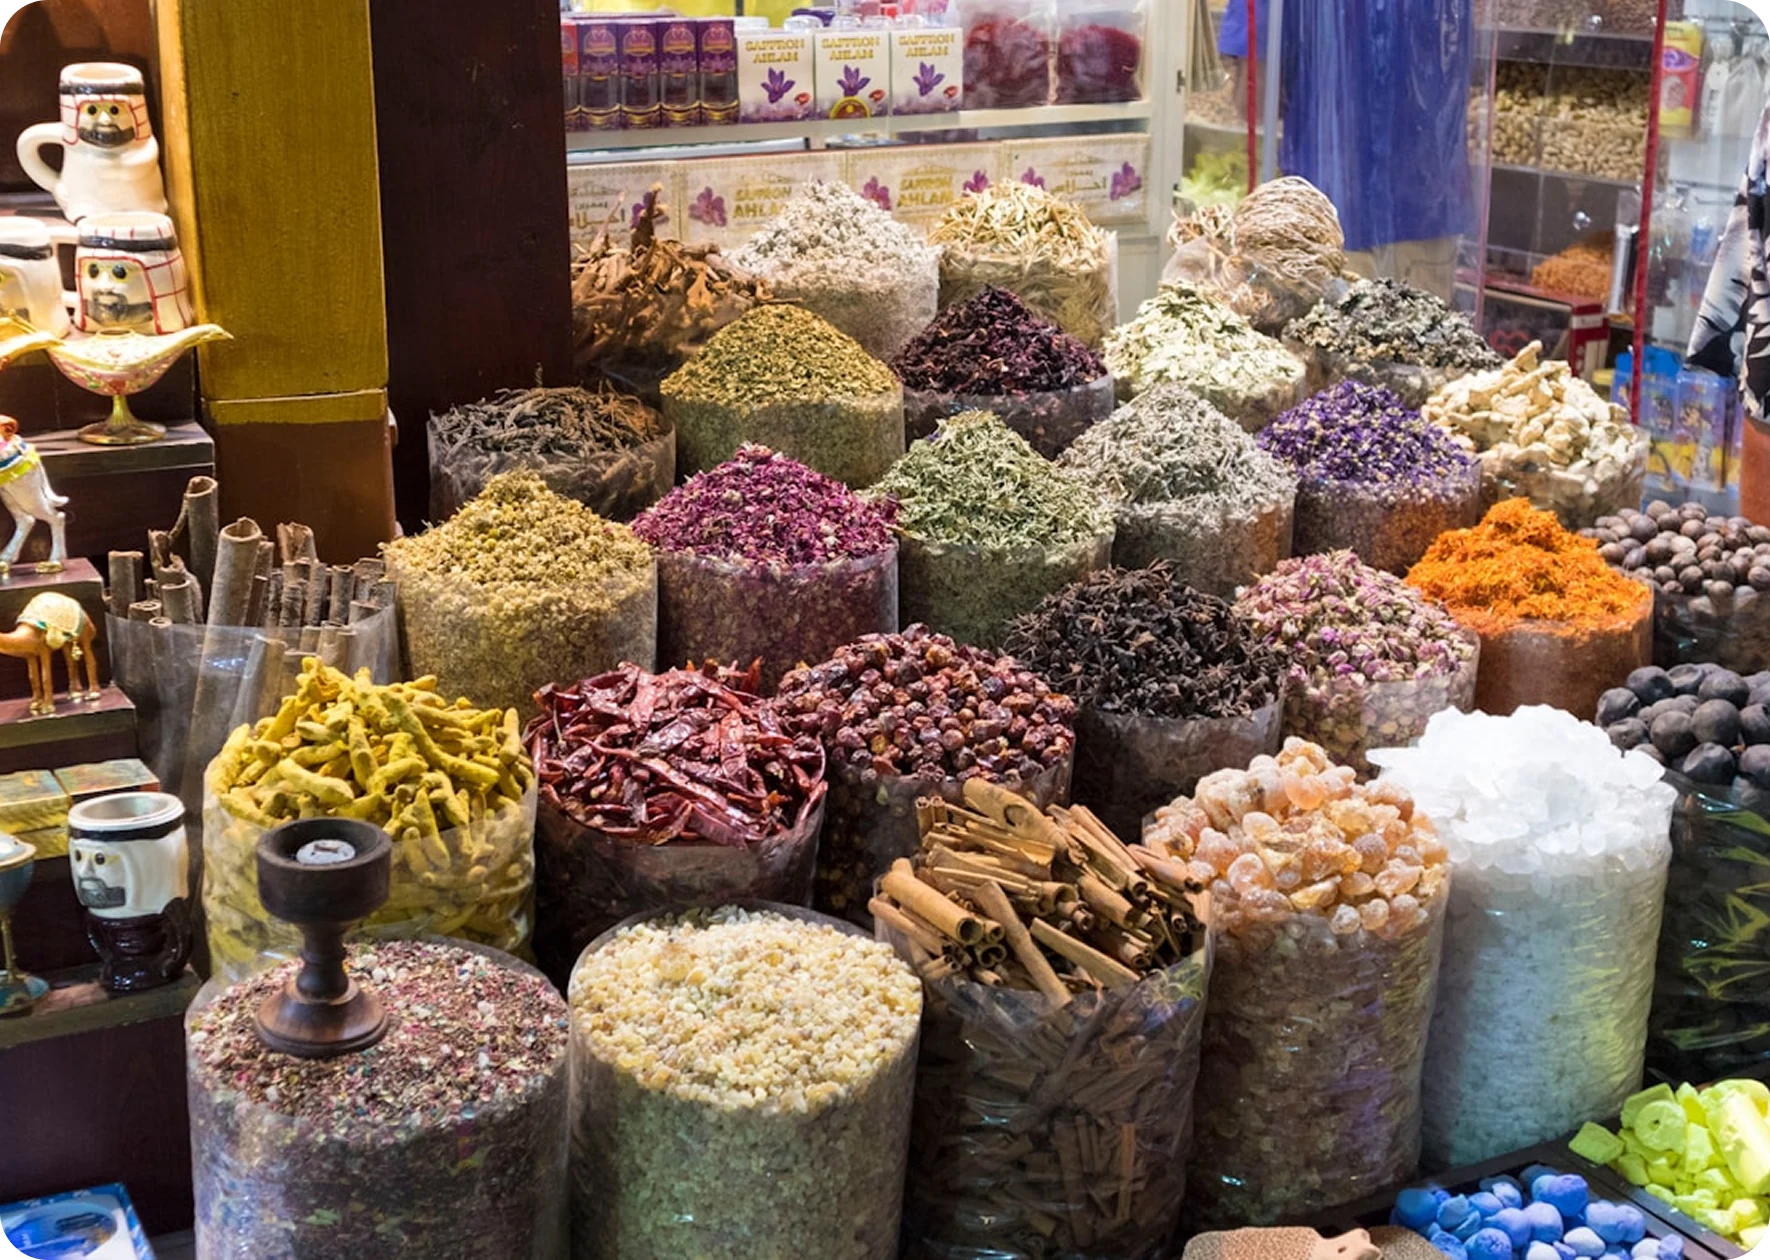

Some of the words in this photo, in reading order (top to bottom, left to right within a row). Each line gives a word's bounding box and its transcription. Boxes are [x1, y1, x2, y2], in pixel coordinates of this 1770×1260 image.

[746, 37, 805, 51] SAFFRON
[822, 36, 880, 50] SAFFRON
[899, 33, 955, 46] SAFFRON
[753, 51, 798, 64] AHLAM
[829, 49, 874, 61] AHLAM
[906, 46, 949, 57] AHLAM
